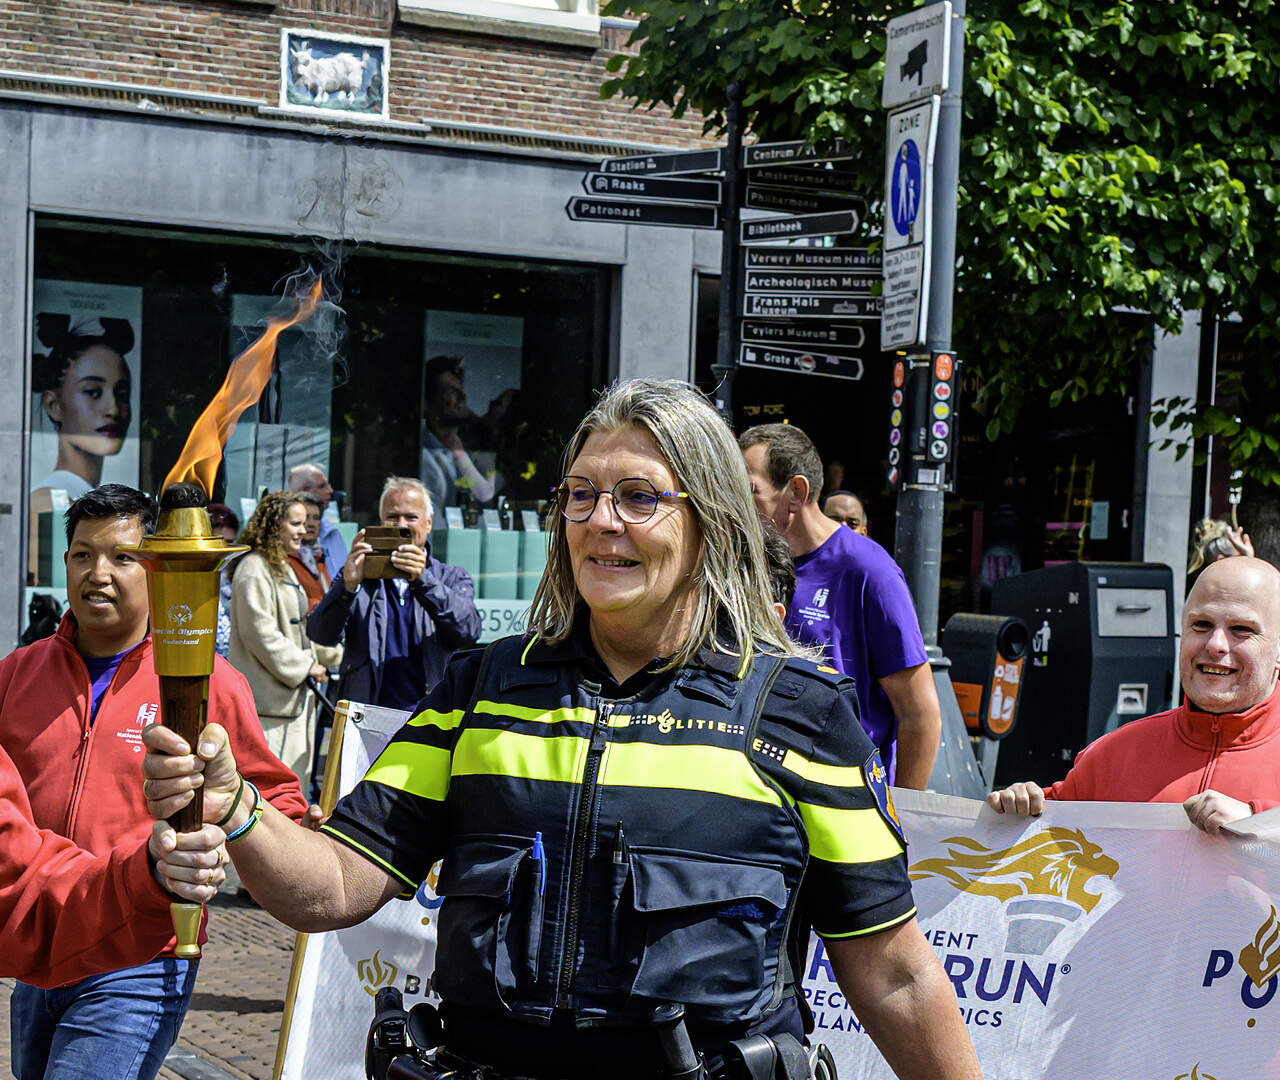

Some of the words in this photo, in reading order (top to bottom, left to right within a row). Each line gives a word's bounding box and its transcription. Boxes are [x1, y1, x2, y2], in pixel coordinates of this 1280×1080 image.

[899, 113, 921, 133] ZONE
[753, 149, 794, 160] Centrum
[610, 160, 645, 172] Station
[611, 178, 646, 191] Raaks
[581, 203, 641, 217] Patronaat
[748, 221, 803, 236] Bibliotheek
[751, 253, 792, 265] Verwey
[795, 253, 842, 264] Museum
[749, 276, 838, 290] Archeologisch
[752, 296, 788, 307] Frans
[792, 297, 820, 307] Hals
[752, 306, 798, 315] Museum
[747, 324, 785, 337] eylers
[787, 328, 828, 339] Museum
[763, 353, 791, 365] Grote
[646, 709, 728, 734] POLITIE
